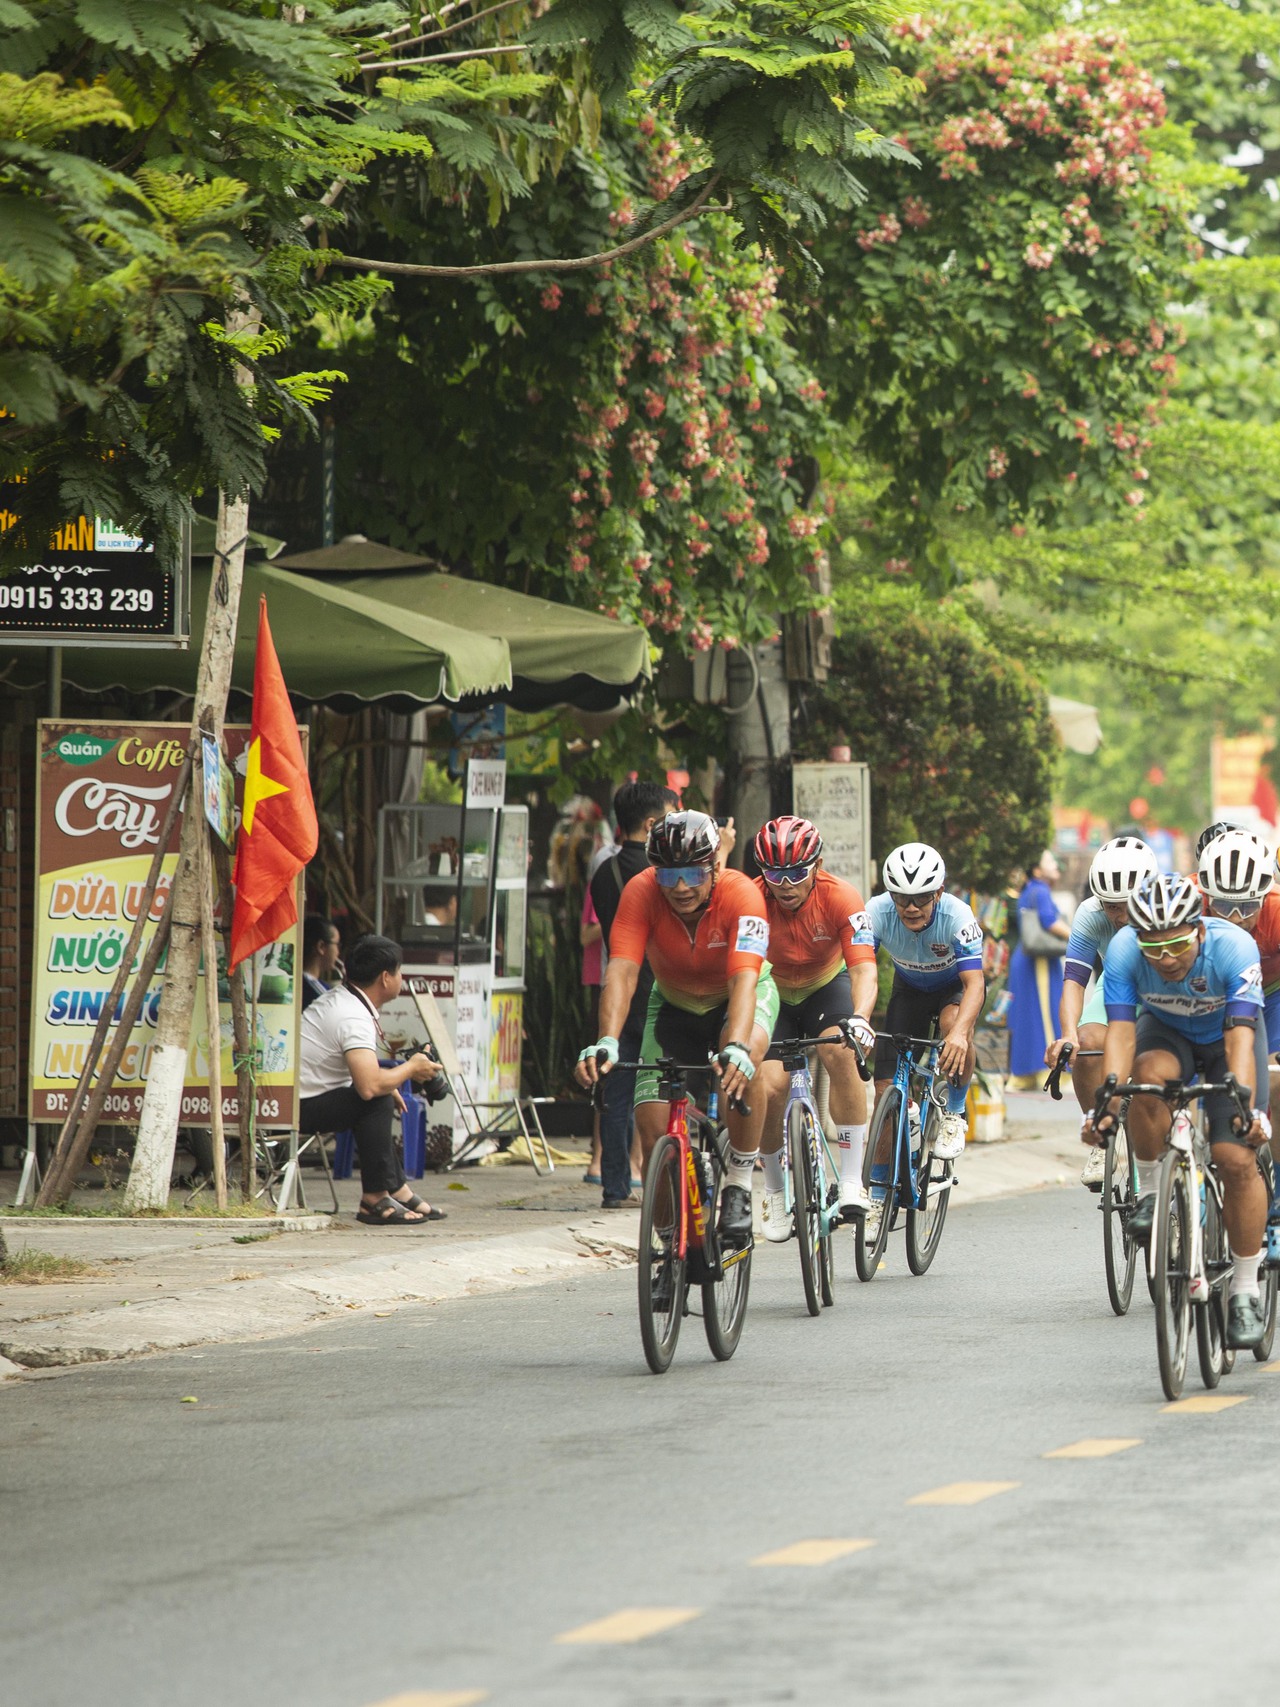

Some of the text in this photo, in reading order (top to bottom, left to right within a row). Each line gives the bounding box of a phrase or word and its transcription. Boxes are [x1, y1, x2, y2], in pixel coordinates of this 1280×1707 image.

[0, 586, 153, 611] 0915 333 239
[59, 740, 102, 757] Quán
[53, 877, 117, 915] DỪA
